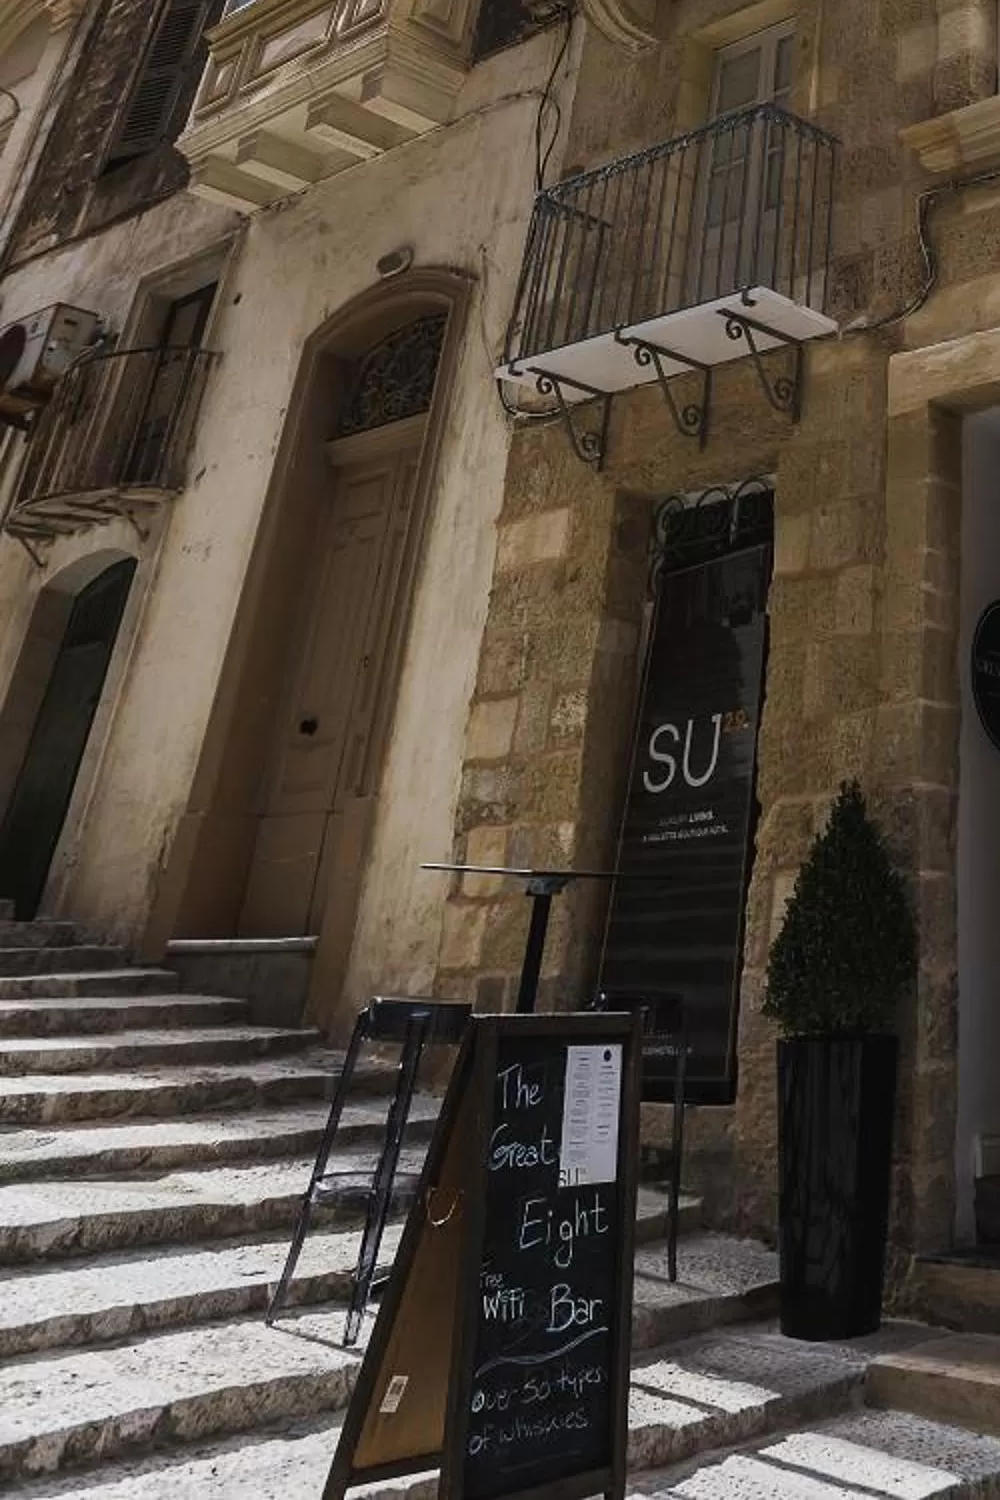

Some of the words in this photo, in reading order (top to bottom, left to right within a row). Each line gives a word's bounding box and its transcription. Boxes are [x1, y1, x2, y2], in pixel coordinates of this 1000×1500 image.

[642, 713, 722, 793] SU
[496, 1061, 544, 1111] The
[489, 1122, 557, 1171] Great
[518, 1194, 610, 1269] Eight
[545, 1282, 604, 1333] Bar
[555, 1362, 603, 1400] types
[468, 1422, 496, 1456] of
